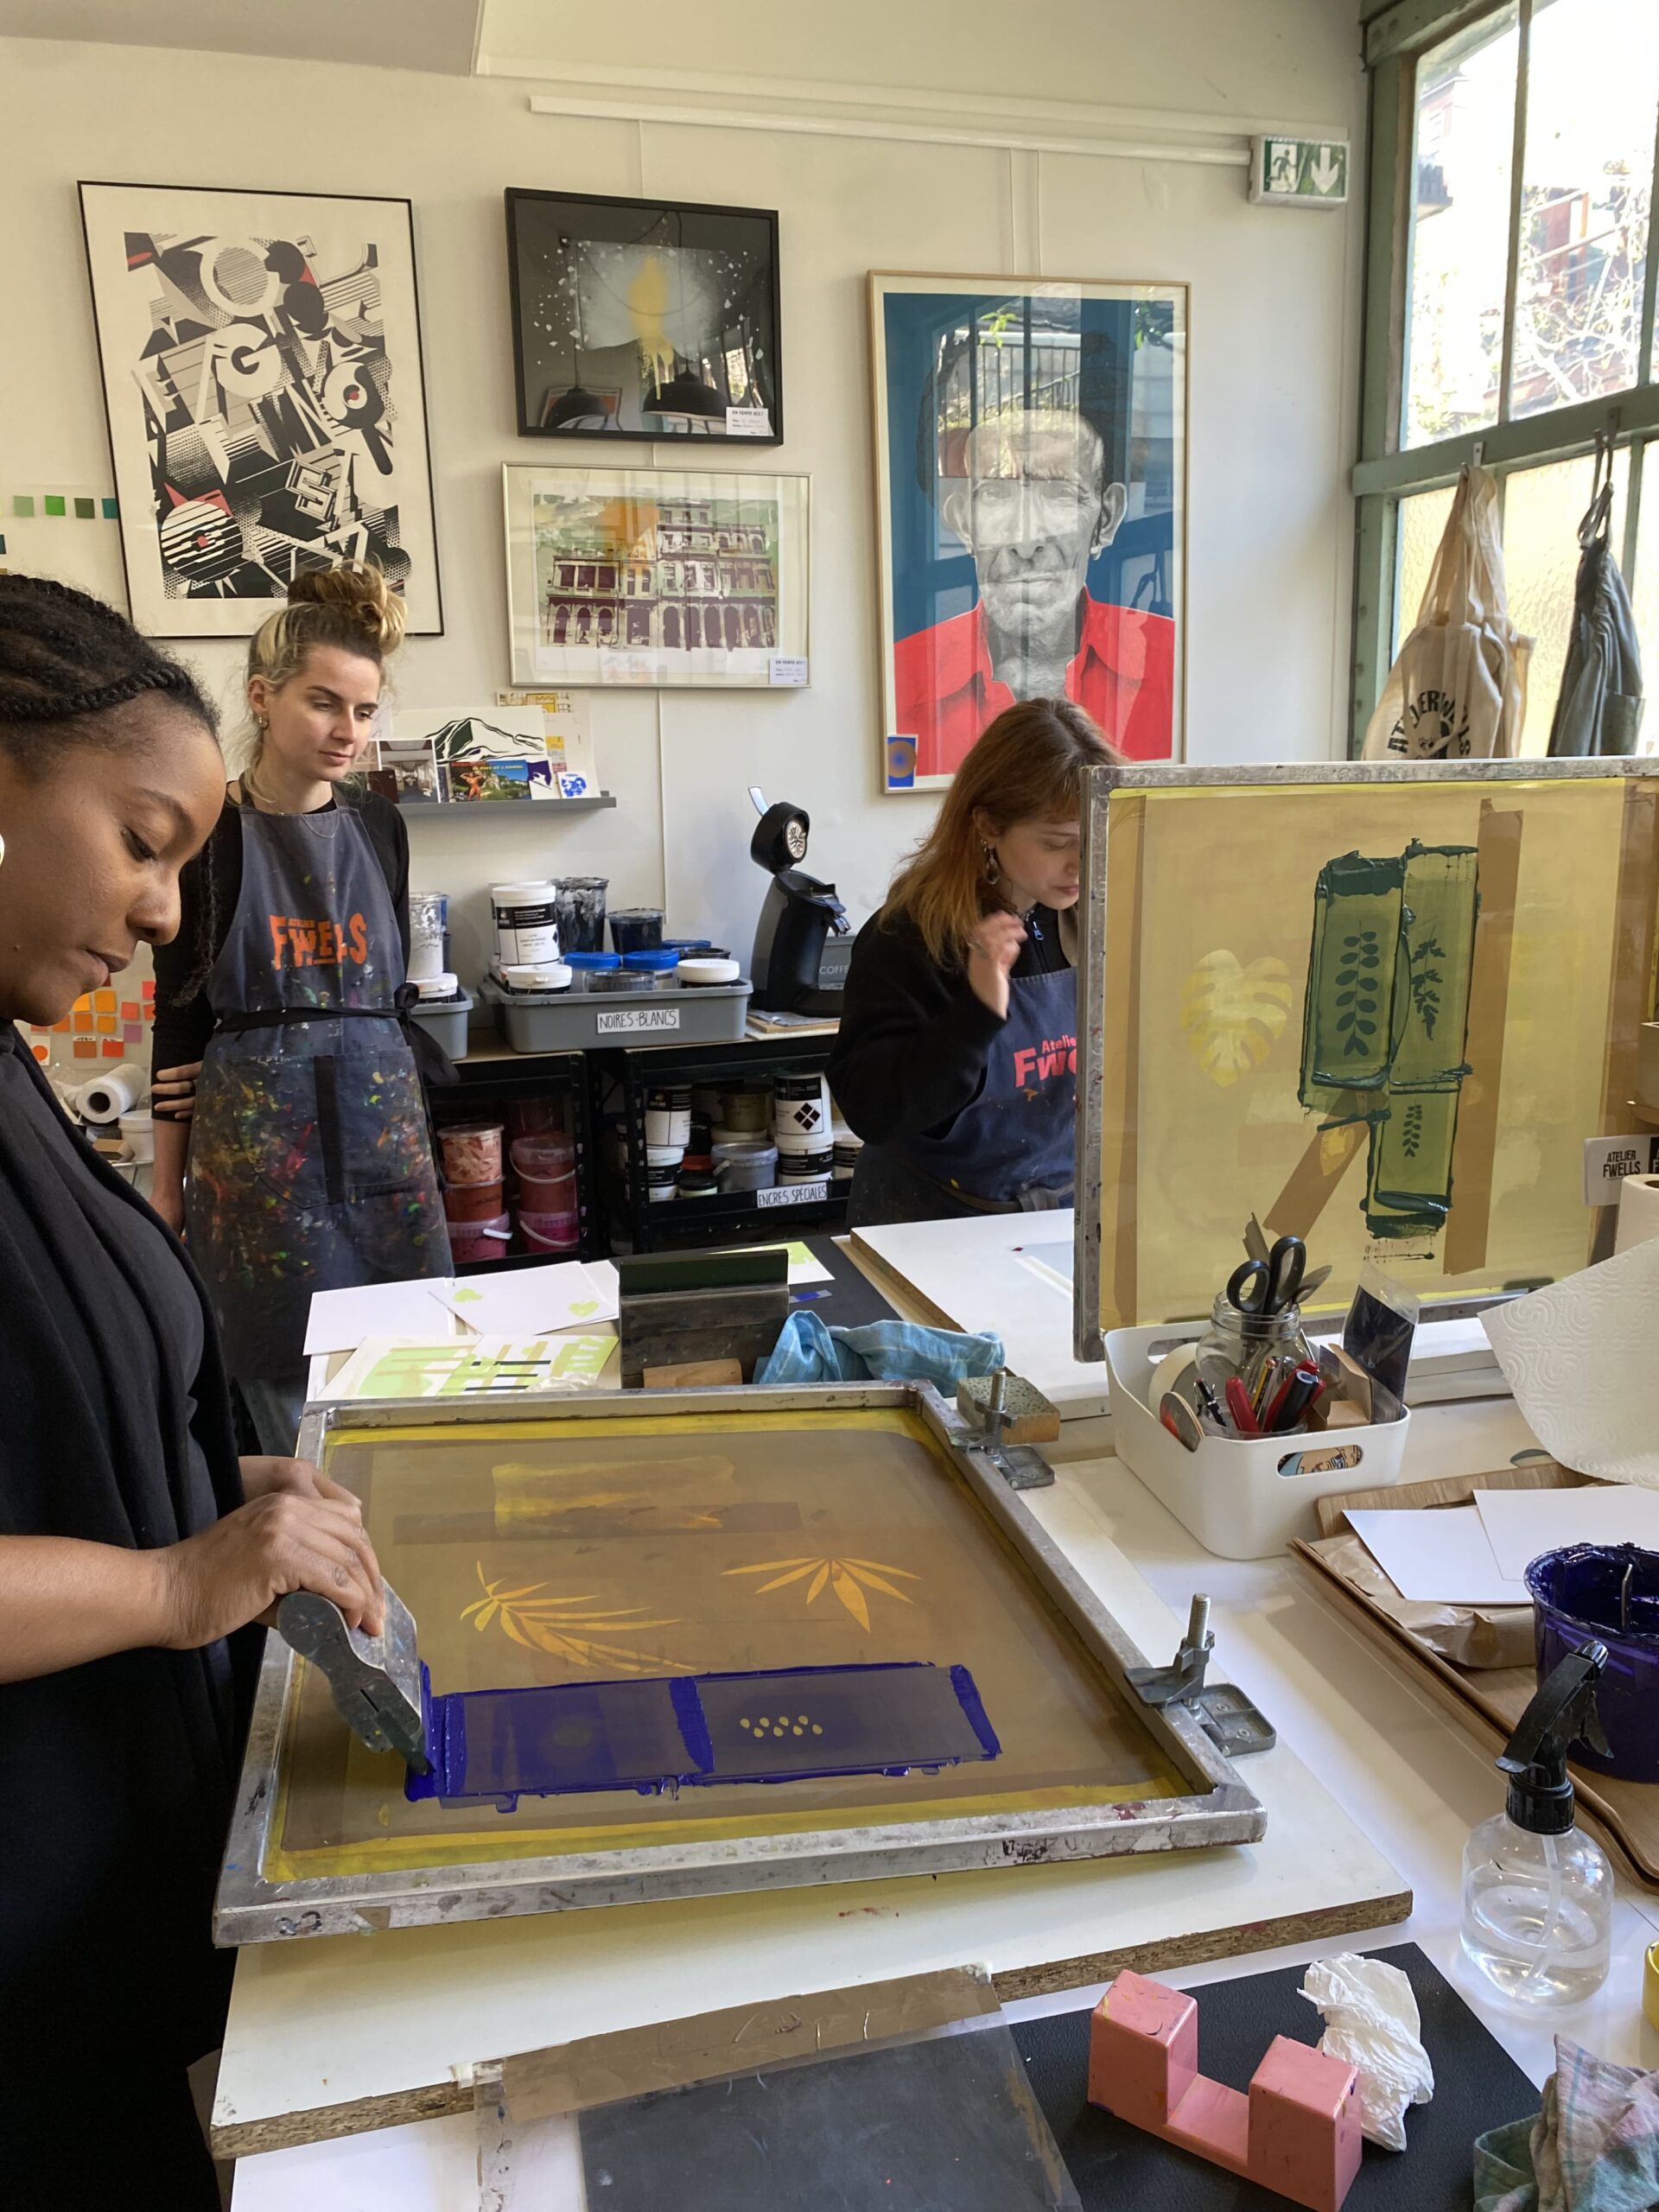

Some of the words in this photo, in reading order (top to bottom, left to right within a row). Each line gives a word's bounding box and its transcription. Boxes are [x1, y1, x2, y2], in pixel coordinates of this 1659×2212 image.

[819, 965, 849, 974] COFFE
[1042, 1034, 1077, 1053] Atelie
[1607, 1150, 1636, 1162] ATELIER
[1603, 1161, 1640, 1177] FWELLS
[759, 1190, 789, 1206] ENCRES
